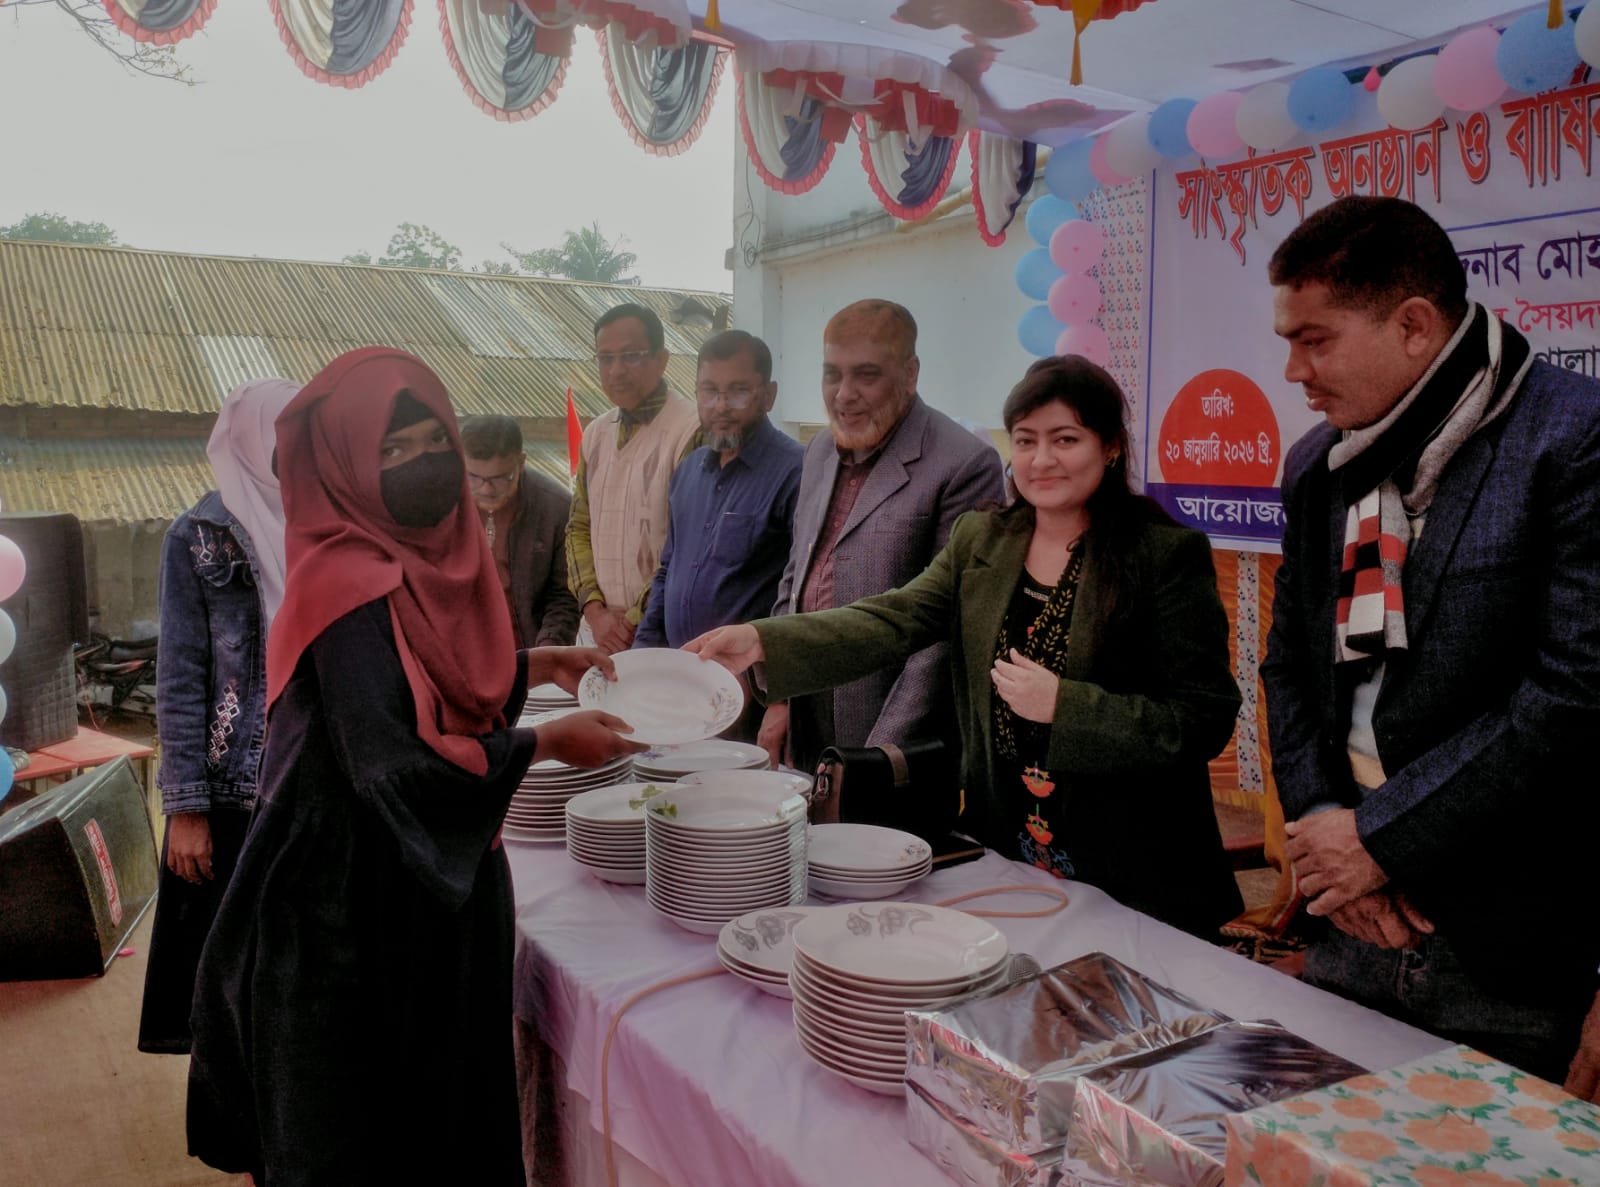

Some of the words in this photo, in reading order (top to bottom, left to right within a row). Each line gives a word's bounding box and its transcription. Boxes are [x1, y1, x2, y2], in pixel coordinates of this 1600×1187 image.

[1319, 116, 1448, 204] অনষ্ঠান
[1456, 111, 1491, 184] ও
[1501, 60, 1600, 188] বার্ষি
[1515, 297, 1600, 332] সৈয়দ
[1165, 439, 1181, 464] ২০
[1183, 431, 1221, 468] জানুয়ারি
[1224, 439, 1254, 466] ২০২৬
[1175, 495, 1288, 527] আয়োজ
